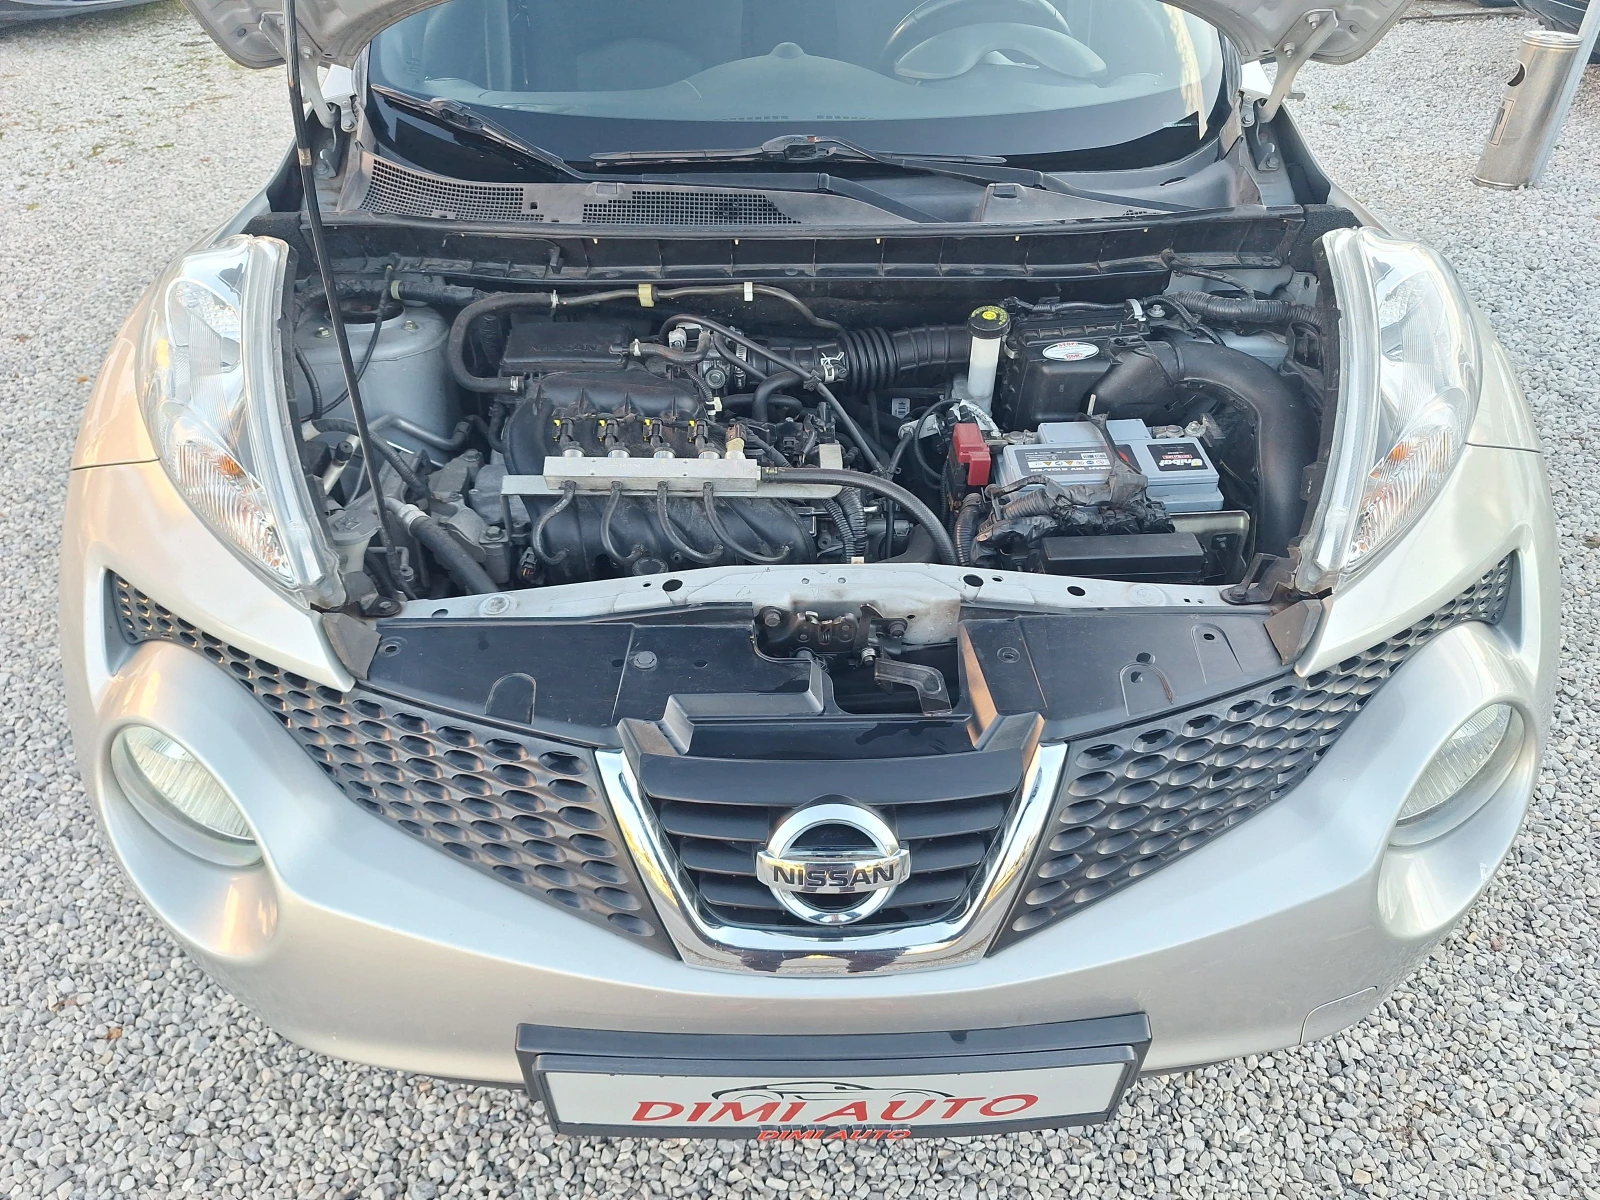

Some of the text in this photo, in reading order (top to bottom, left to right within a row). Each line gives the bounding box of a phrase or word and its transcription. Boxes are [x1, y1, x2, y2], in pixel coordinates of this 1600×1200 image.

[1159, 459, 1203, 467] Unibat
[773, 864, 894, 887] NISSAN
[632, 1094, 1039, 1122] DIMI AUTO
[757, 1128, 912, 1141] DIMI AUTO
